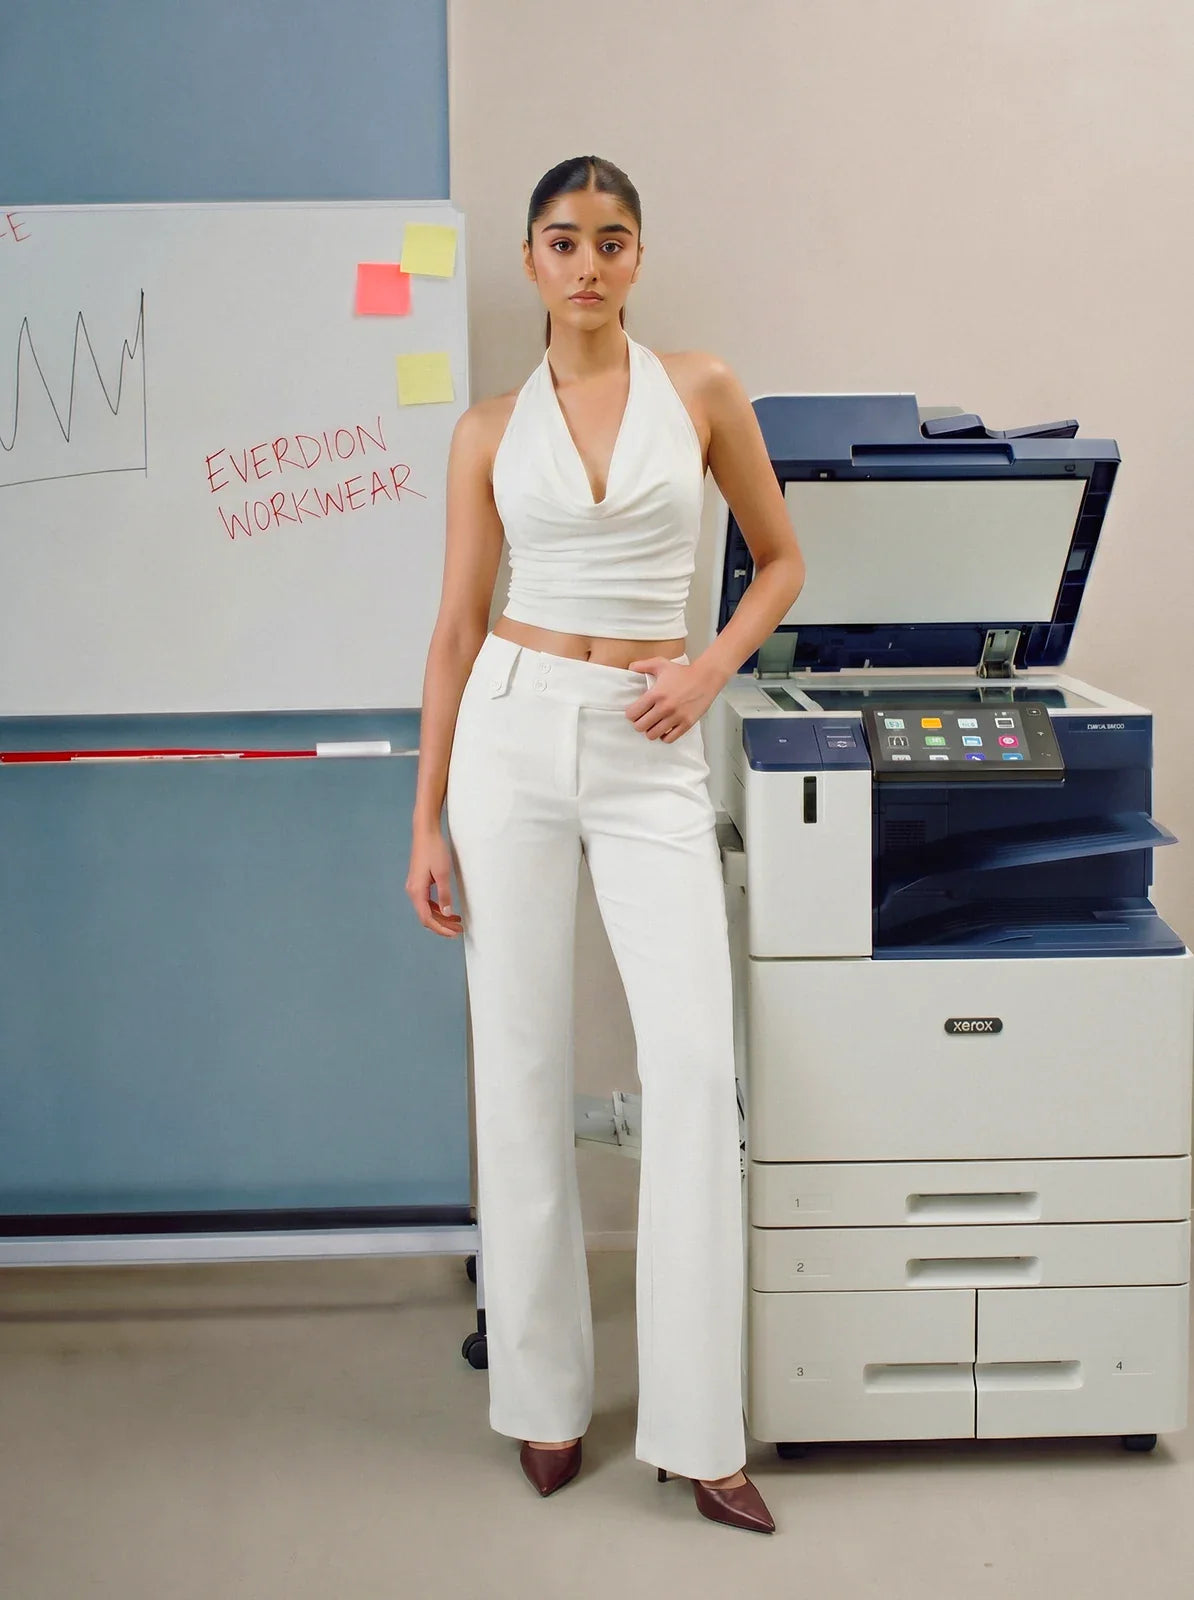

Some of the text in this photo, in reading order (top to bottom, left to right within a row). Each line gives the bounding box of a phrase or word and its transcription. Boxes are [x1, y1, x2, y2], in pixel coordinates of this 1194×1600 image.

[0, 212, 32, 242] E
[205, 416, 387, 493] EVERDION
[218, 463, 427, 540] WORKWEAR
[953, 1020, 993, 1032] xerox
[796, 1262, 805, 1273] 2
[796, 1366, 804, 1377] 3
[1115, 1360, 1123, 1371] 4
